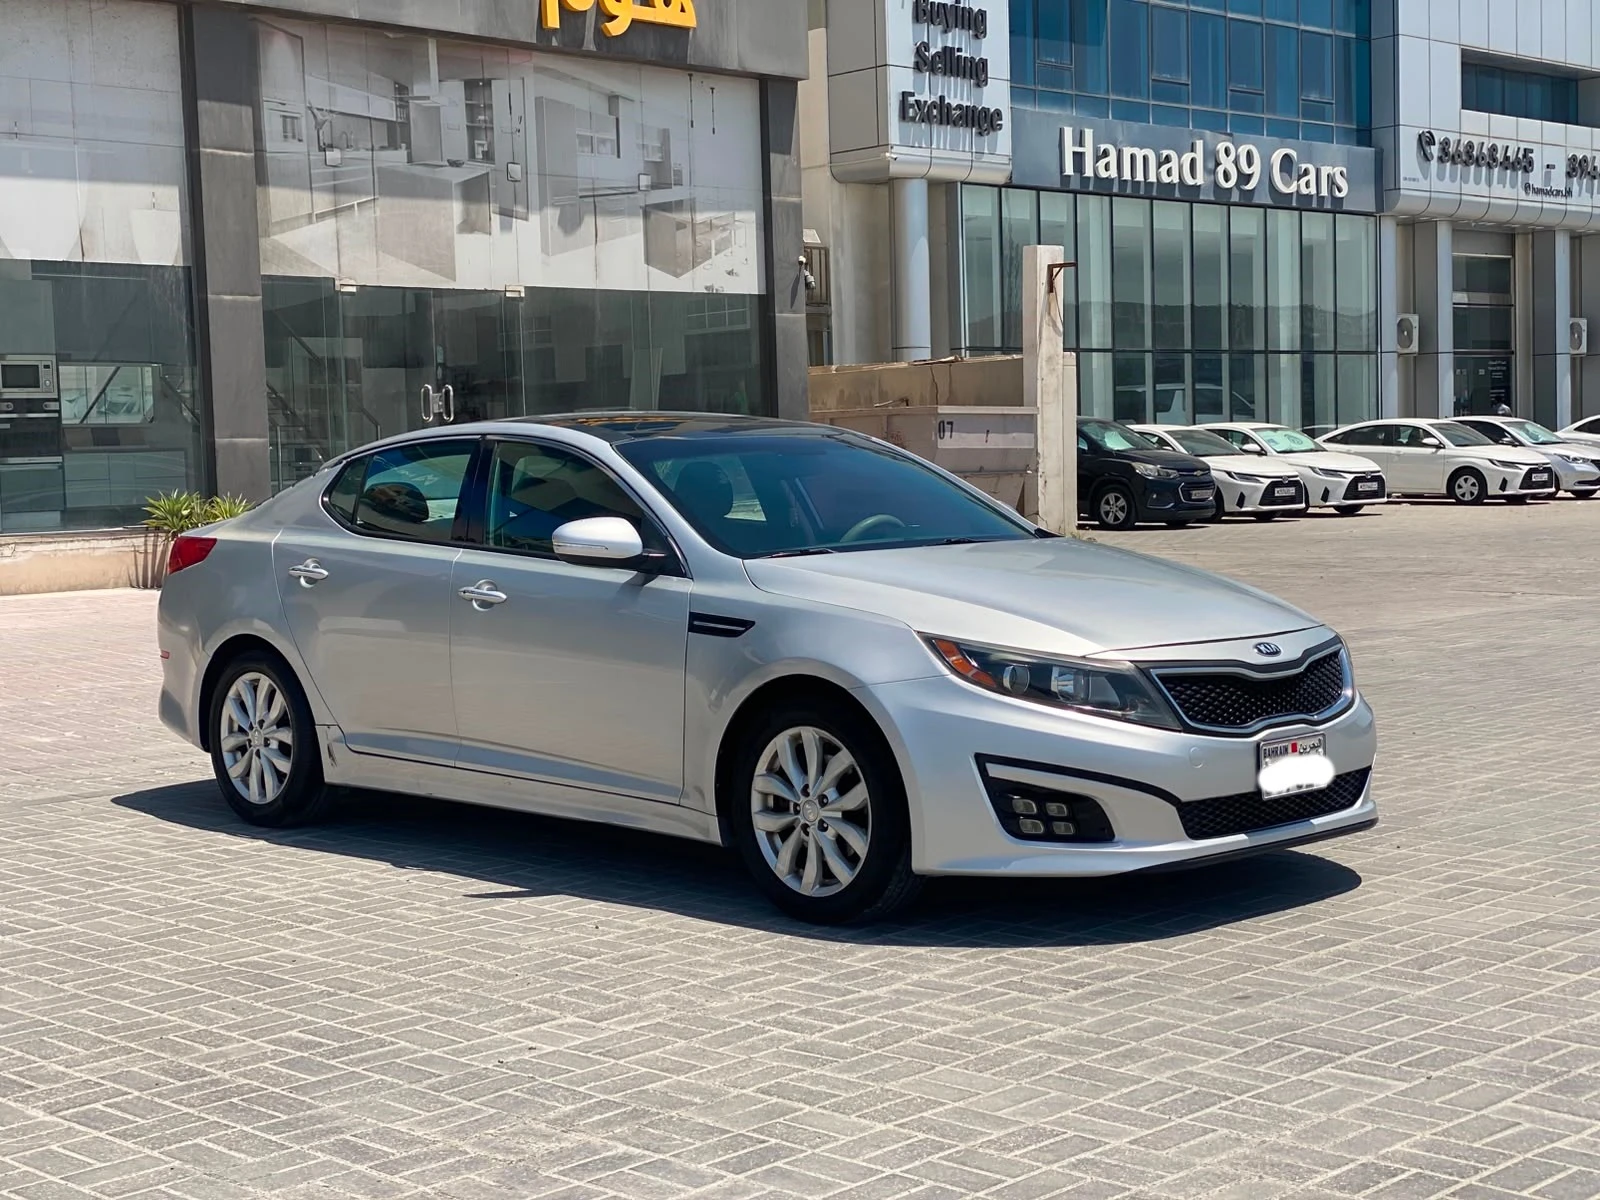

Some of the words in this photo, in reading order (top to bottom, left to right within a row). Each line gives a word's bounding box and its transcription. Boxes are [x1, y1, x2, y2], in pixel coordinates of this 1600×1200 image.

[914, 0, 987, 39] Buying
[914, 41, 988, 88] Selling
[900, 91, 1003, 136] Exchange
[1060, 126, 1204, 186] Hamad
[1214, 141, 1261, 190] 89
[1269, 148, 1349, 198] Cars
[1567, 154, 1600, 180] 394
[1256, 643, 1281, 654] KIA
[1263, 744, 1289, 758] BAHRAIN
